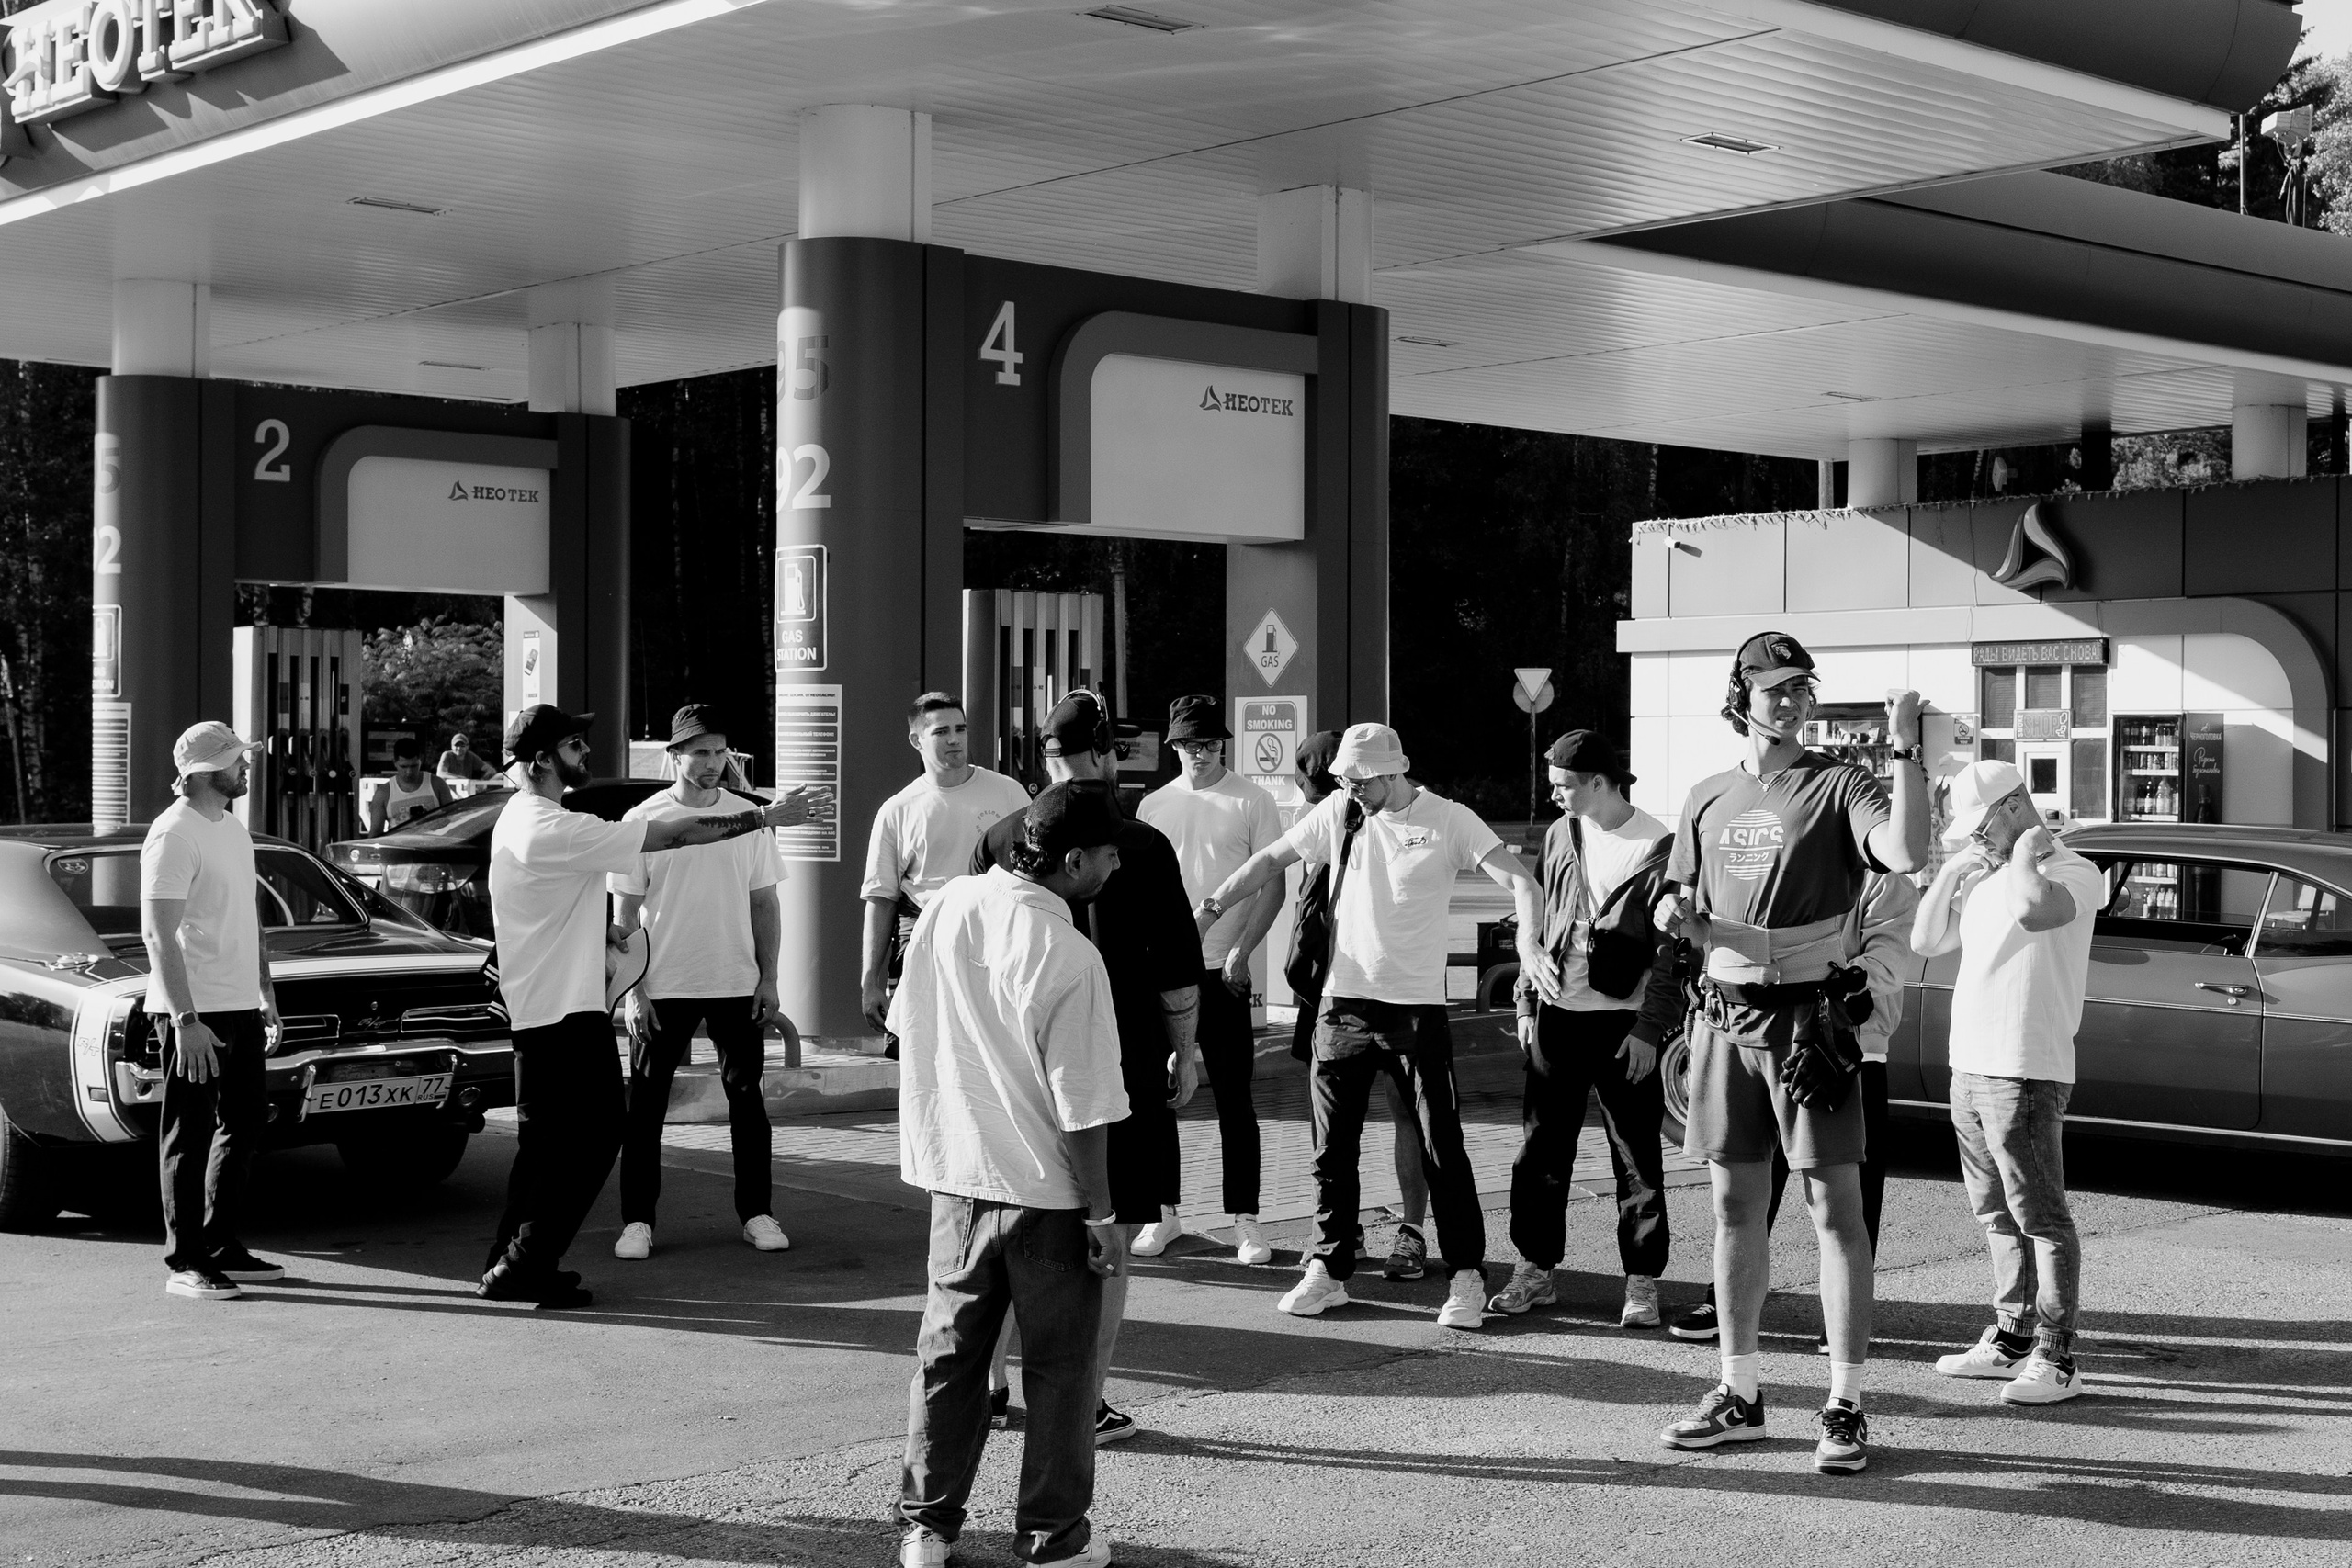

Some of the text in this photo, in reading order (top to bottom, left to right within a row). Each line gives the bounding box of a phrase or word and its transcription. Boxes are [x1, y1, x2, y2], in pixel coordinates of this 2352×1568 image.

[978, 301, 1023, 387] 4
[254, 418, 291, 482] 2
[93, 525, 122, 574] 2
[782, 629, 804, 643] GAS
[776, 646, 818, 661] STATION
[1261, 655, 1280, 668] GAS
[1973, 647, 1999, 662] РАДЫ
[2002, 646, 2039, 663] ВИДЕТЬ
[2041, 645, 2060, 661] ВАС
[1261, 705, 1277, 716] NO
[1246, 719, 1294, 731] SMOKING
[2024, 714, 2060, 739] SHOP
[1251, 775, 1286, 786] THANK
[1718, 825, 1784, 846] ASICS
[1728, 851, 1770, 863] ランニング
[423, 1077, 445, 1095] 77
